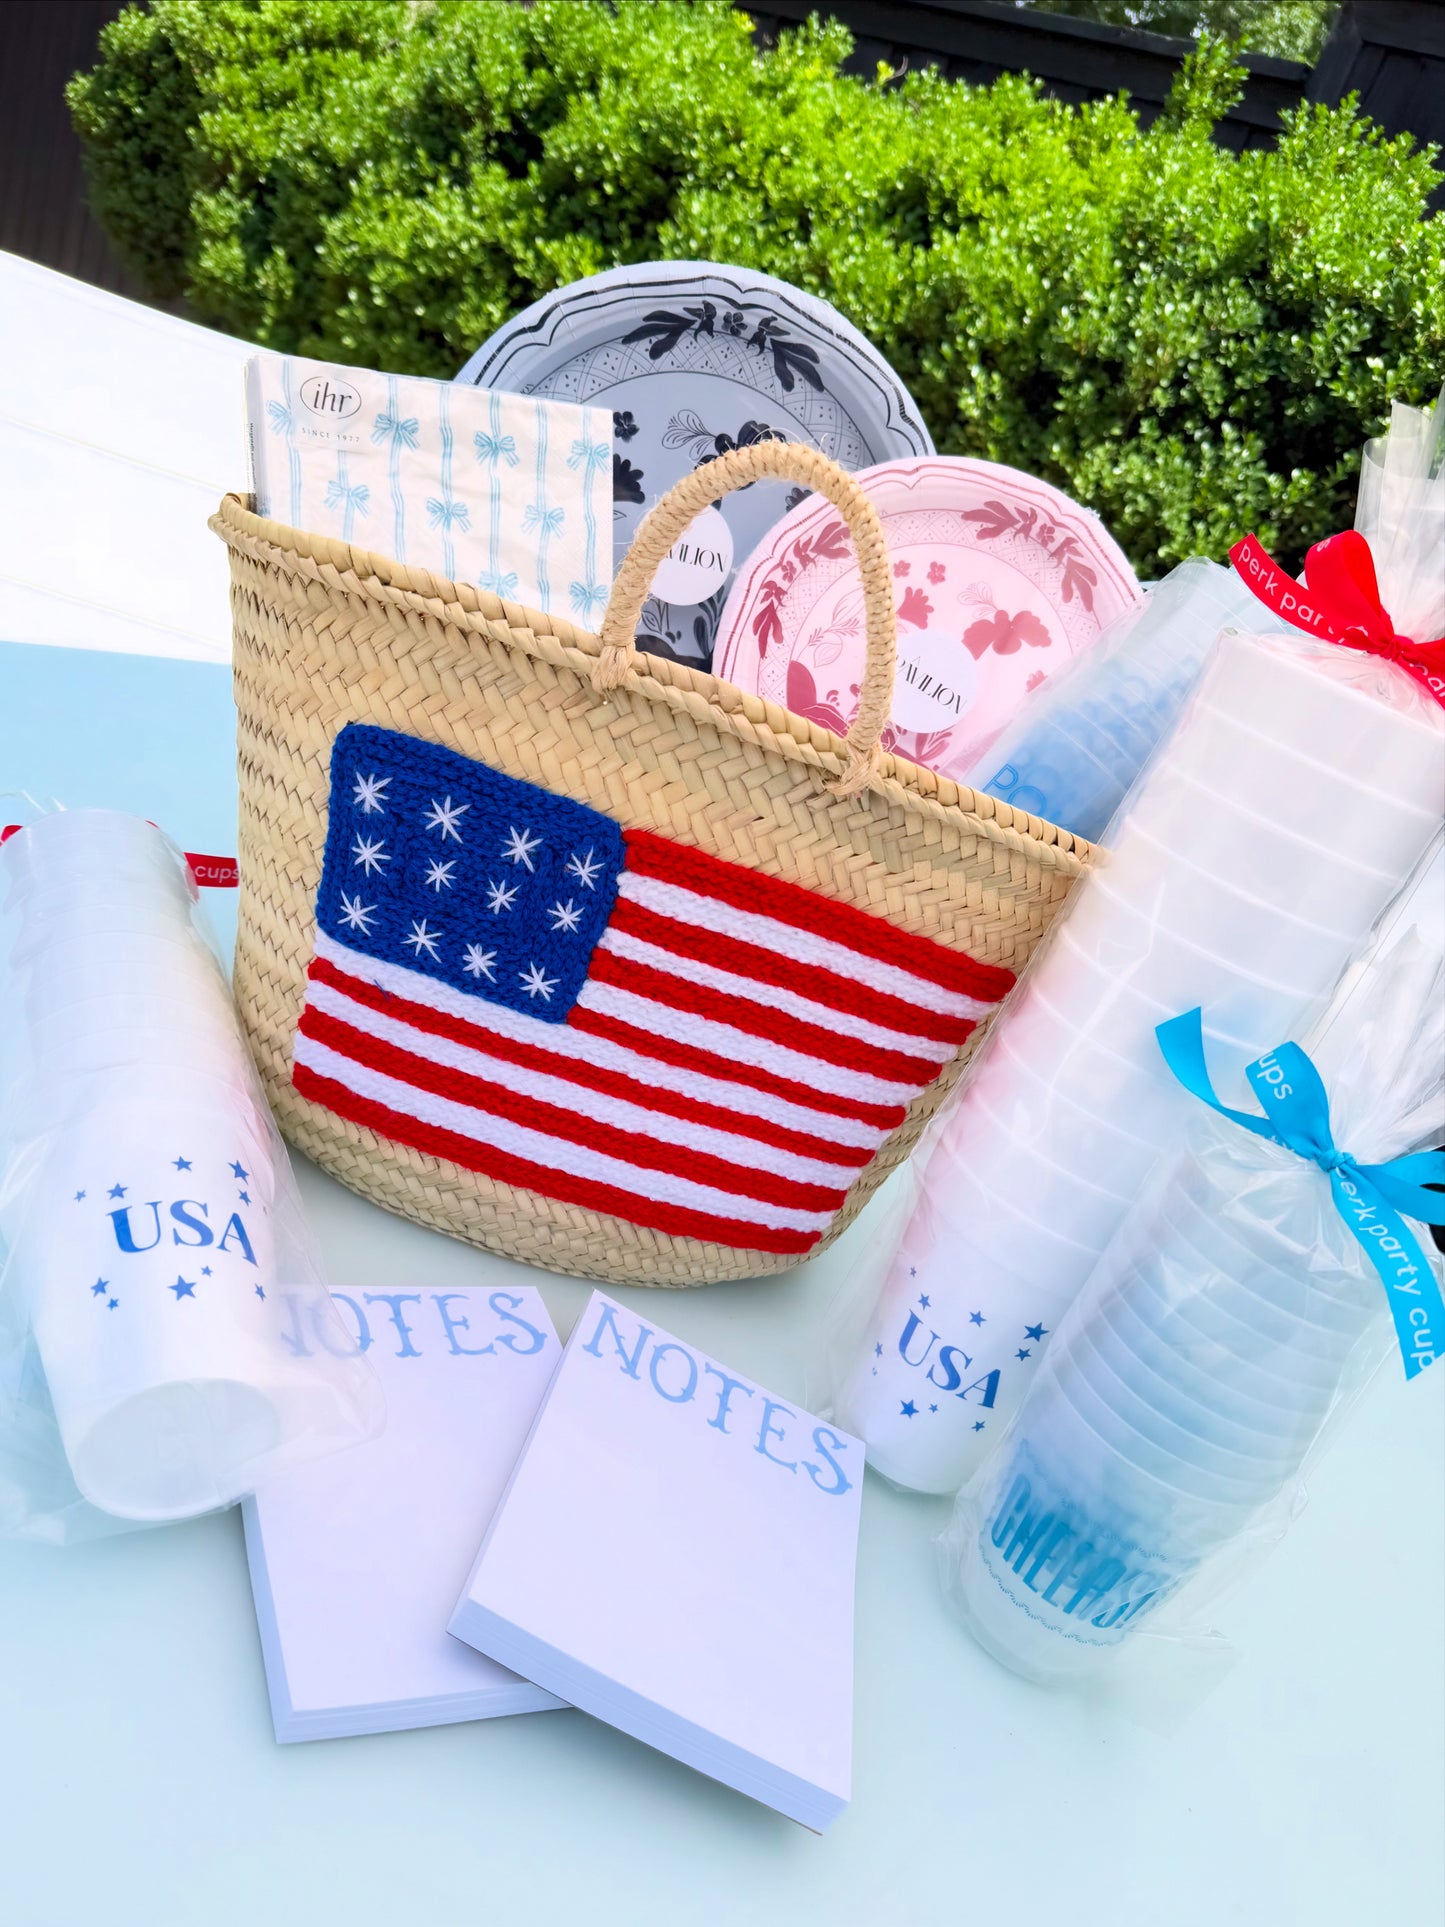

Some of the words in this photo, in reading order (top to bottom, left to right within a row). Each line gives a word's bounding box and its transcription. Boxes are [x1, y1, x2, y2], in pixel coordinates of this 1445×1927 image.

[313, 381, 353, 413] ihr
[302, 427, 330, 439] SINCE
[667, 543, 728, 573] VILION
[1238, 543, 1276, 597] perk
[195, 865, 239, 884] cups
[1256, 1051, 1293, 1100] ups
[105, 1199, 259, 1268] USA
[1359, 1223, 1422, 1296] party
[898, 1308, 1001, 1409] USA
[581, 1300, 854, 1497] NOTES
